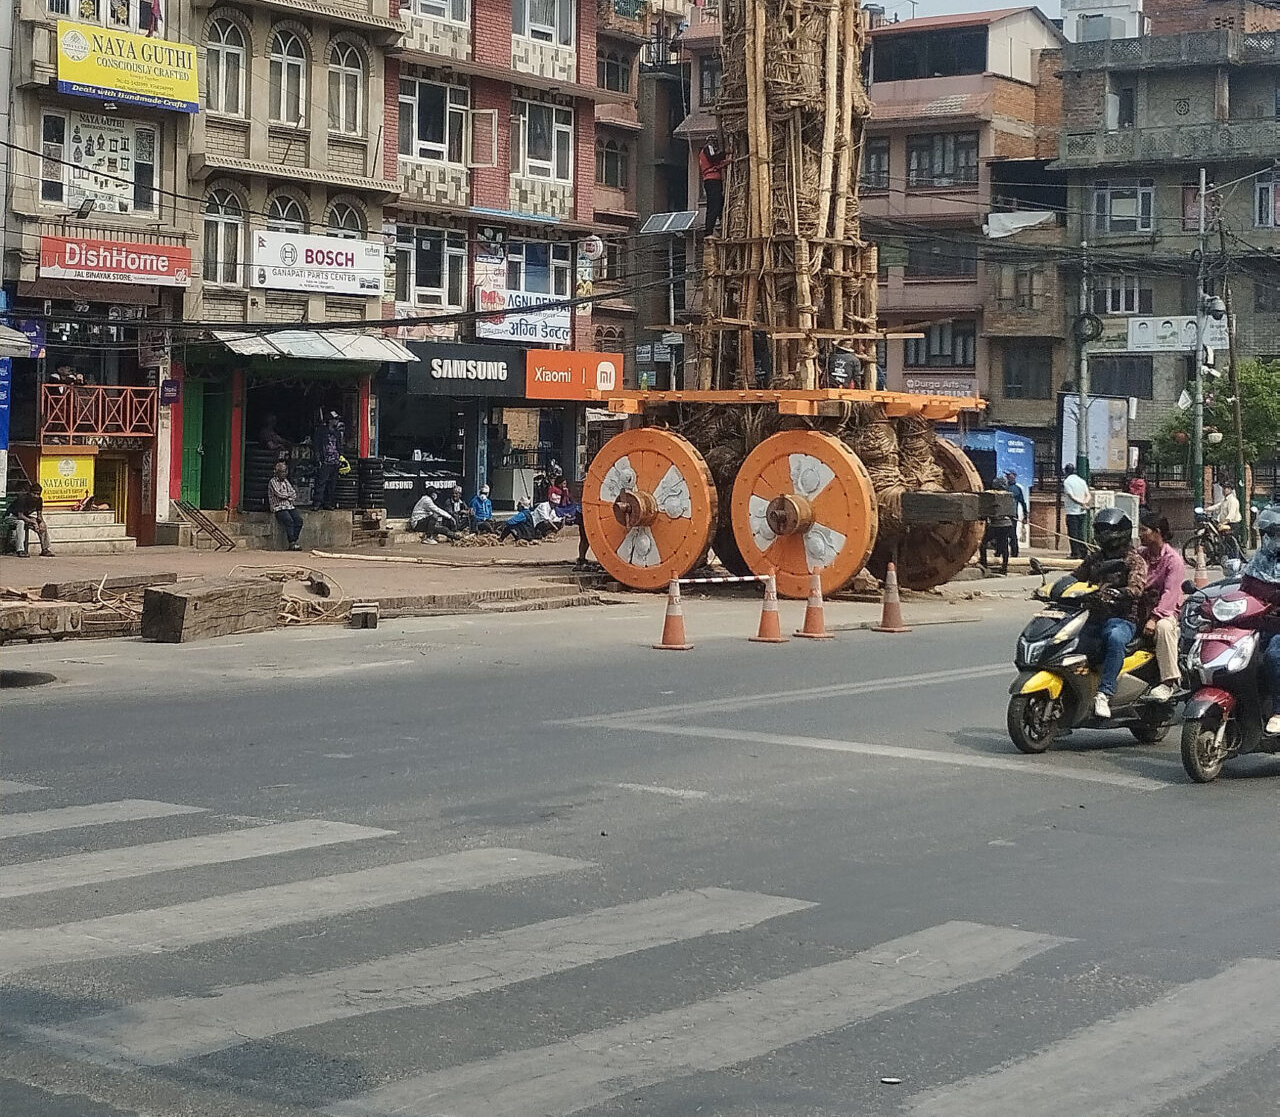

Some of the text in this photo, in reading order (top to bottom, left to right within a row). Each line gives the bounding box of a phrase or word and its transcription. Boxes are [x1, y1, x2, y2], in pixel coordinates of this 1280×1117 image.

[92, 34, 193, 70] NAYA GUTHI
[96, 56, 190, 82] CONSCIOUSLY CRAFTED
[72, 84, 95, 95] Deals
[97, 88, 117, 97] with
[118, 91, 162, 104] Handmade
[163, 99, 188, 109] Crafts
[64, 242, 169, 272] DishHome
[305, 248, 355, 268] BOSCH
[73, 270, 85, 279] JAL
[86, 271, 112, 280] BINAYAK
[272, 268, 306, 279] GANAPATI
[307, 271, 329, 280] PARTS
[330, 273, 356, 282] CENTER
[508, 293, 532, 308] AGNI
[508, 318, 537, 338] अग्नि
[431, 358, 508, 381] SAMSUNG
[534, 366, 572, 383] Xiaomi
[914, 380, 940, 389] Durga
[43, 478, 88, 488] NAYA GUTHI
[383, 481, 414, 490] AMSUNG
